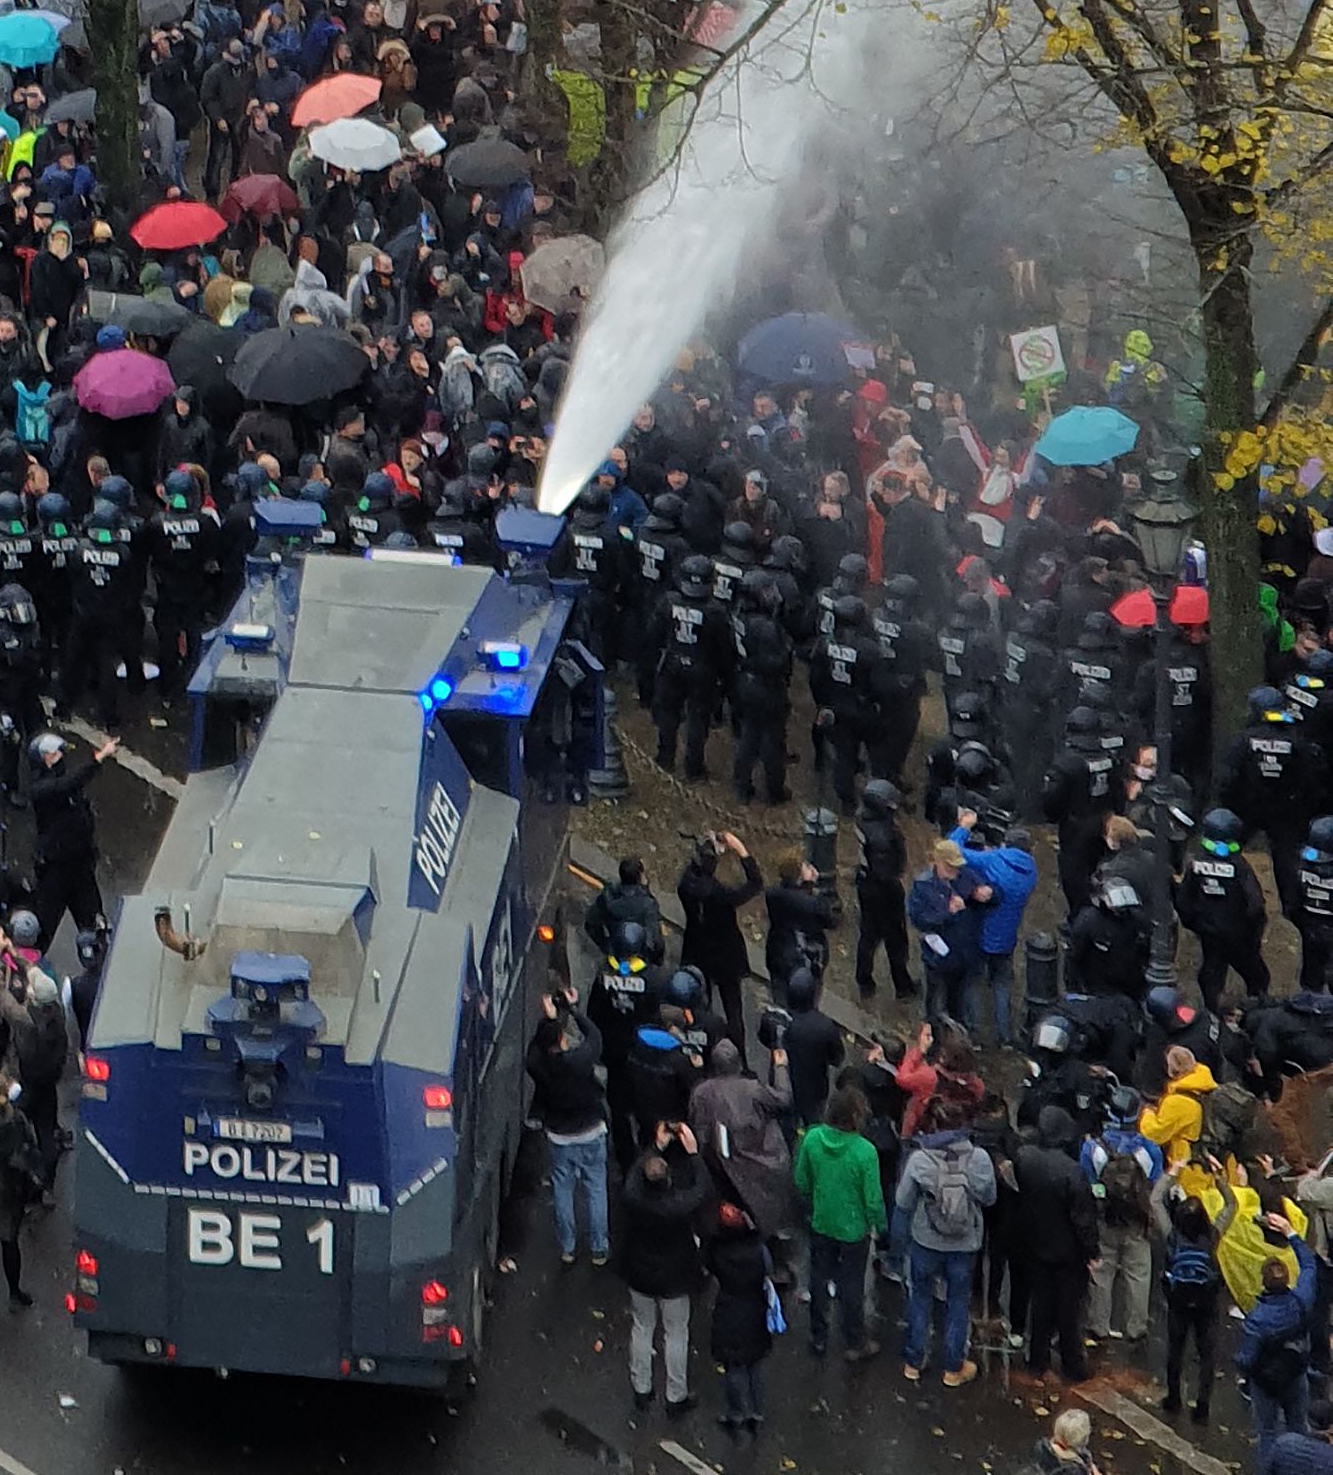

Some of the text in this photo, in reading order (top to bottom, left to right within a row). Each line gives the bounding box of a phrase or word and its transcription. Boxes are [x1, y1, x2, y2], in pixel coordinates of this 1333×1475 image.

[163, 519, 199, 536] POLIZEI
[82, 549, 120, 568] POLIZEI
[415, 781, 462, 895] POLIZEI
[1193, 860, 1234, 877] POLIZEI
[184, 1141, 339, 1187] POLIZEI
[188, 1209, 333, 1275] BE 1
